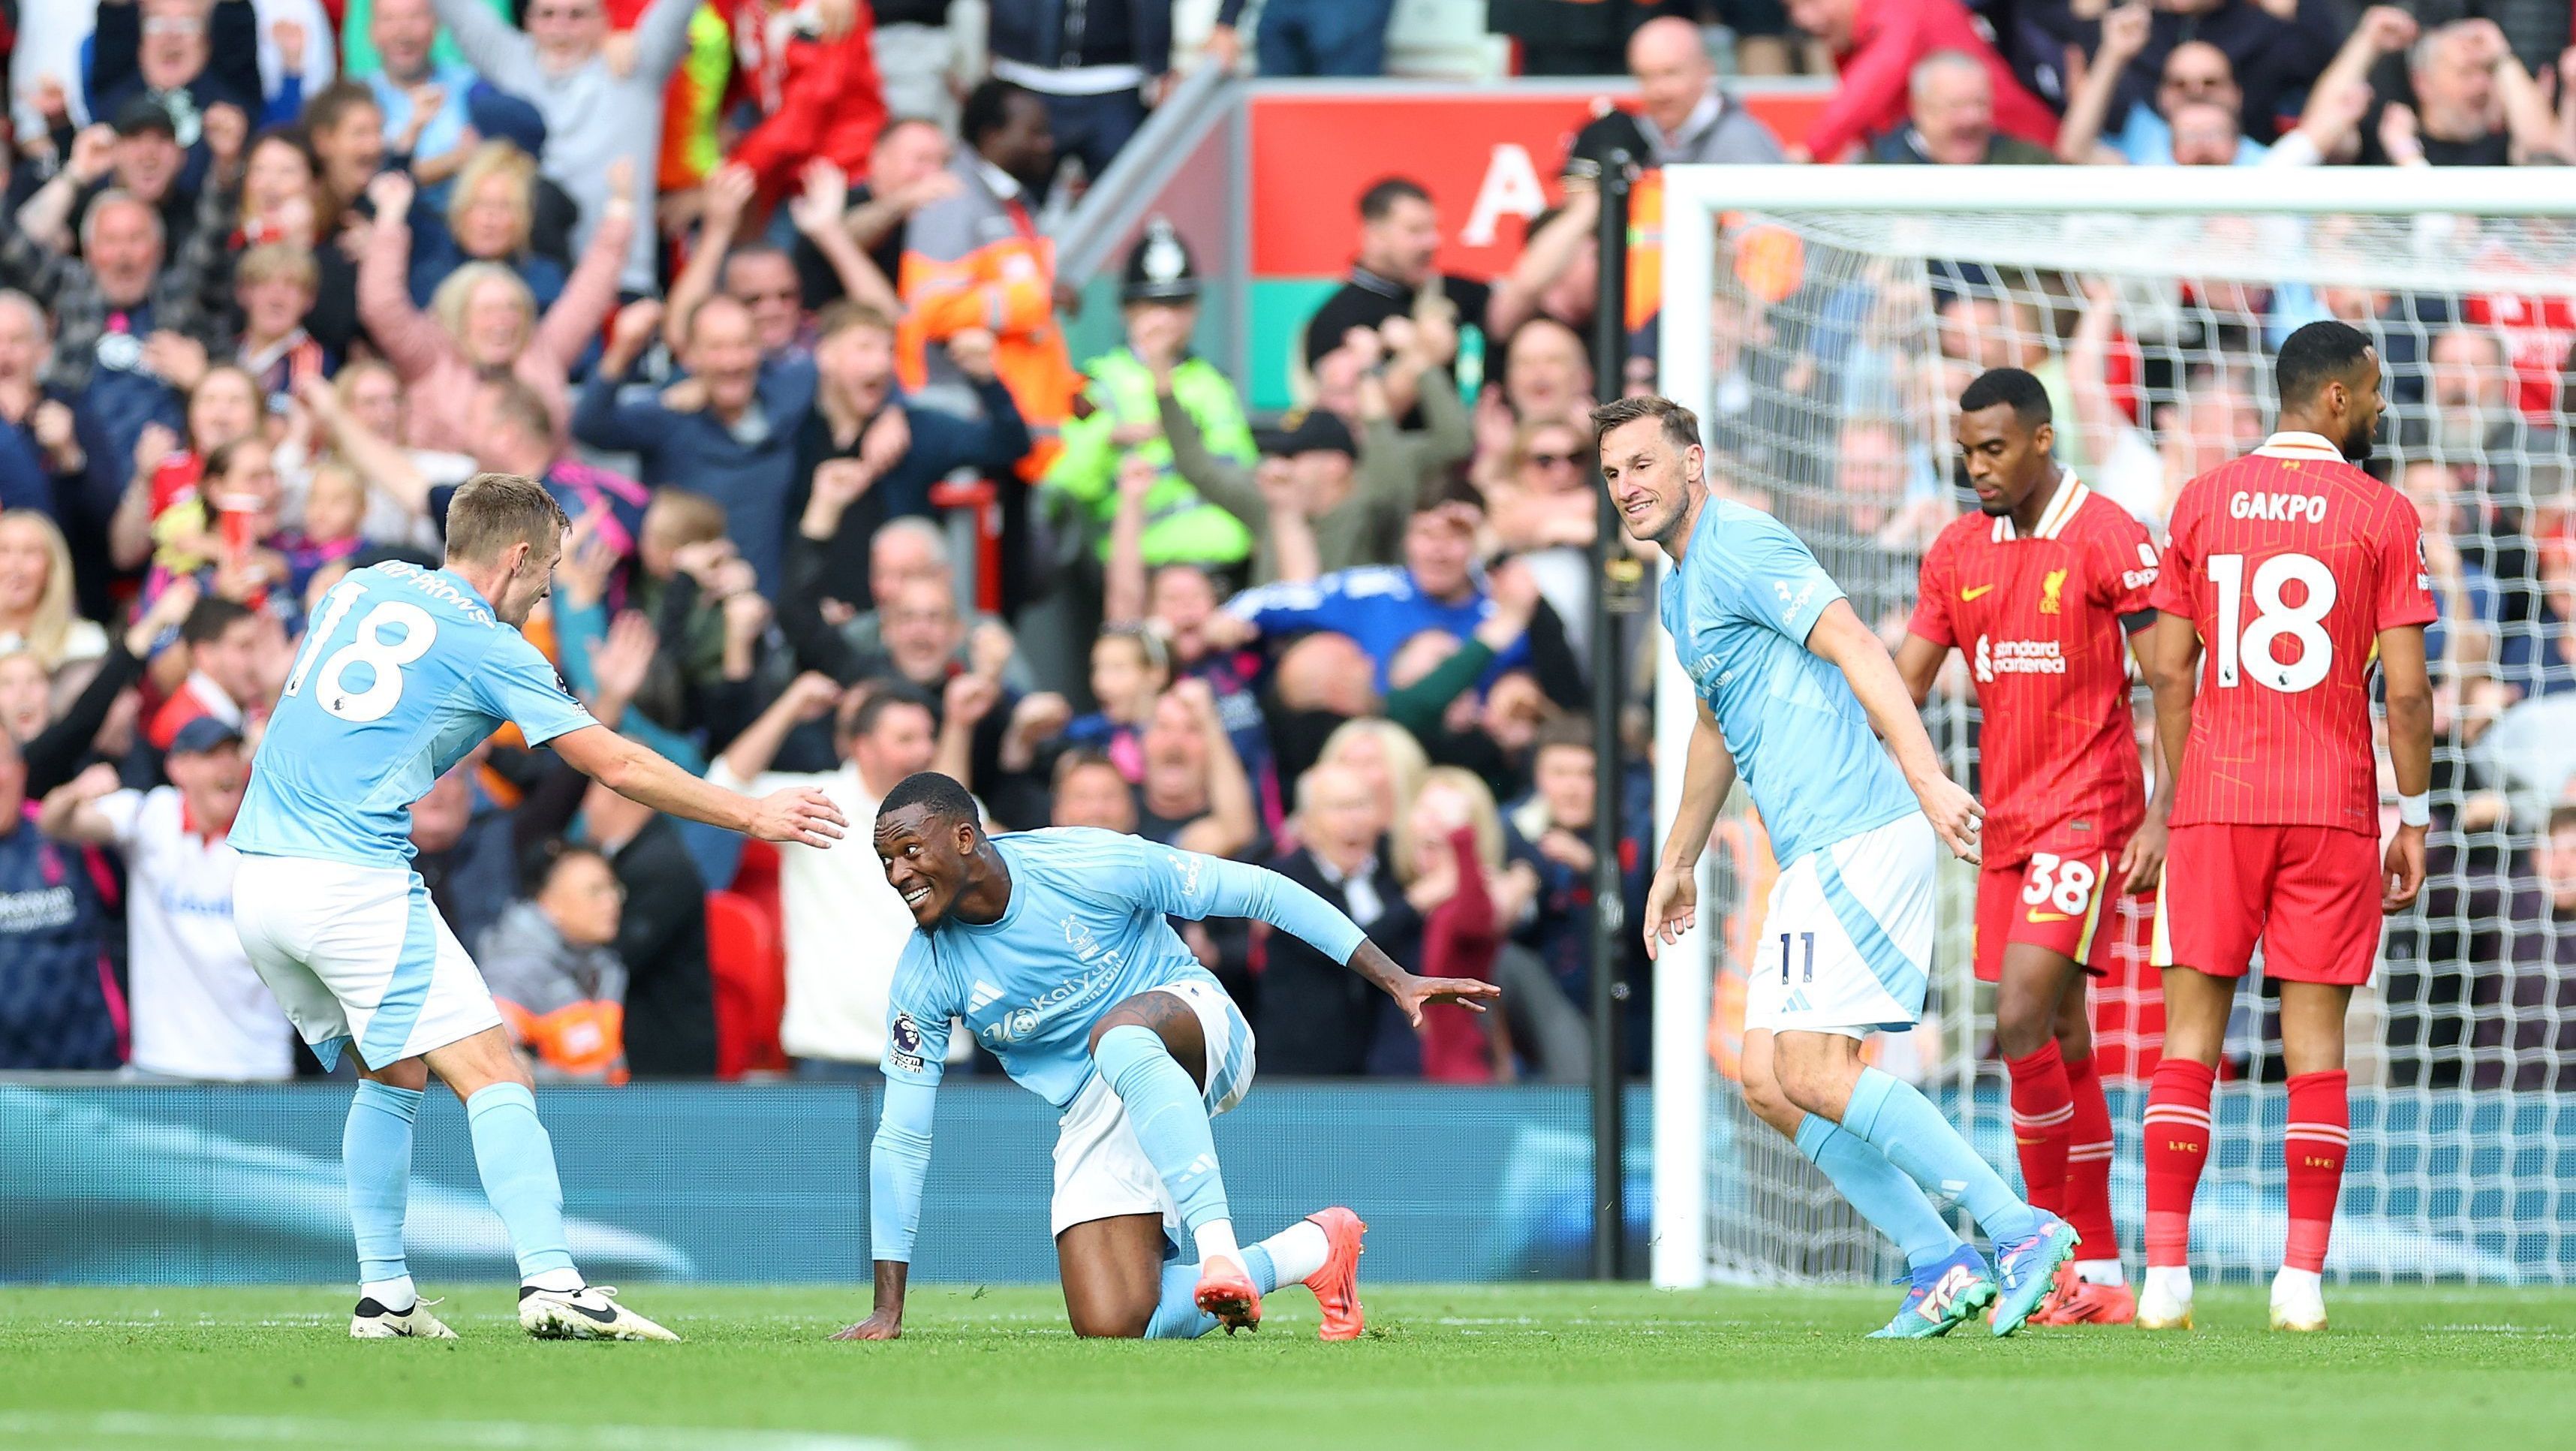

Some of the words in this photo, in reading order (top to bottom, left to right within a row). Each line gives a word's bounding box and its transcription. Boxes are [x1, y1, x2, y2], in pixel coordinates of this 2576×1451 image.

[2230, 491, 2327, 523] GAKPO
[2122, 567, 2160, 590] Exp
[1994, 639, 2060, 658] stndard
[2207, 552, 2337, 693] 18
[284, 581, 438, 722] 18
[2022, 852, 2095, 916] 38
[1781, 932, 1814, 985] 11
